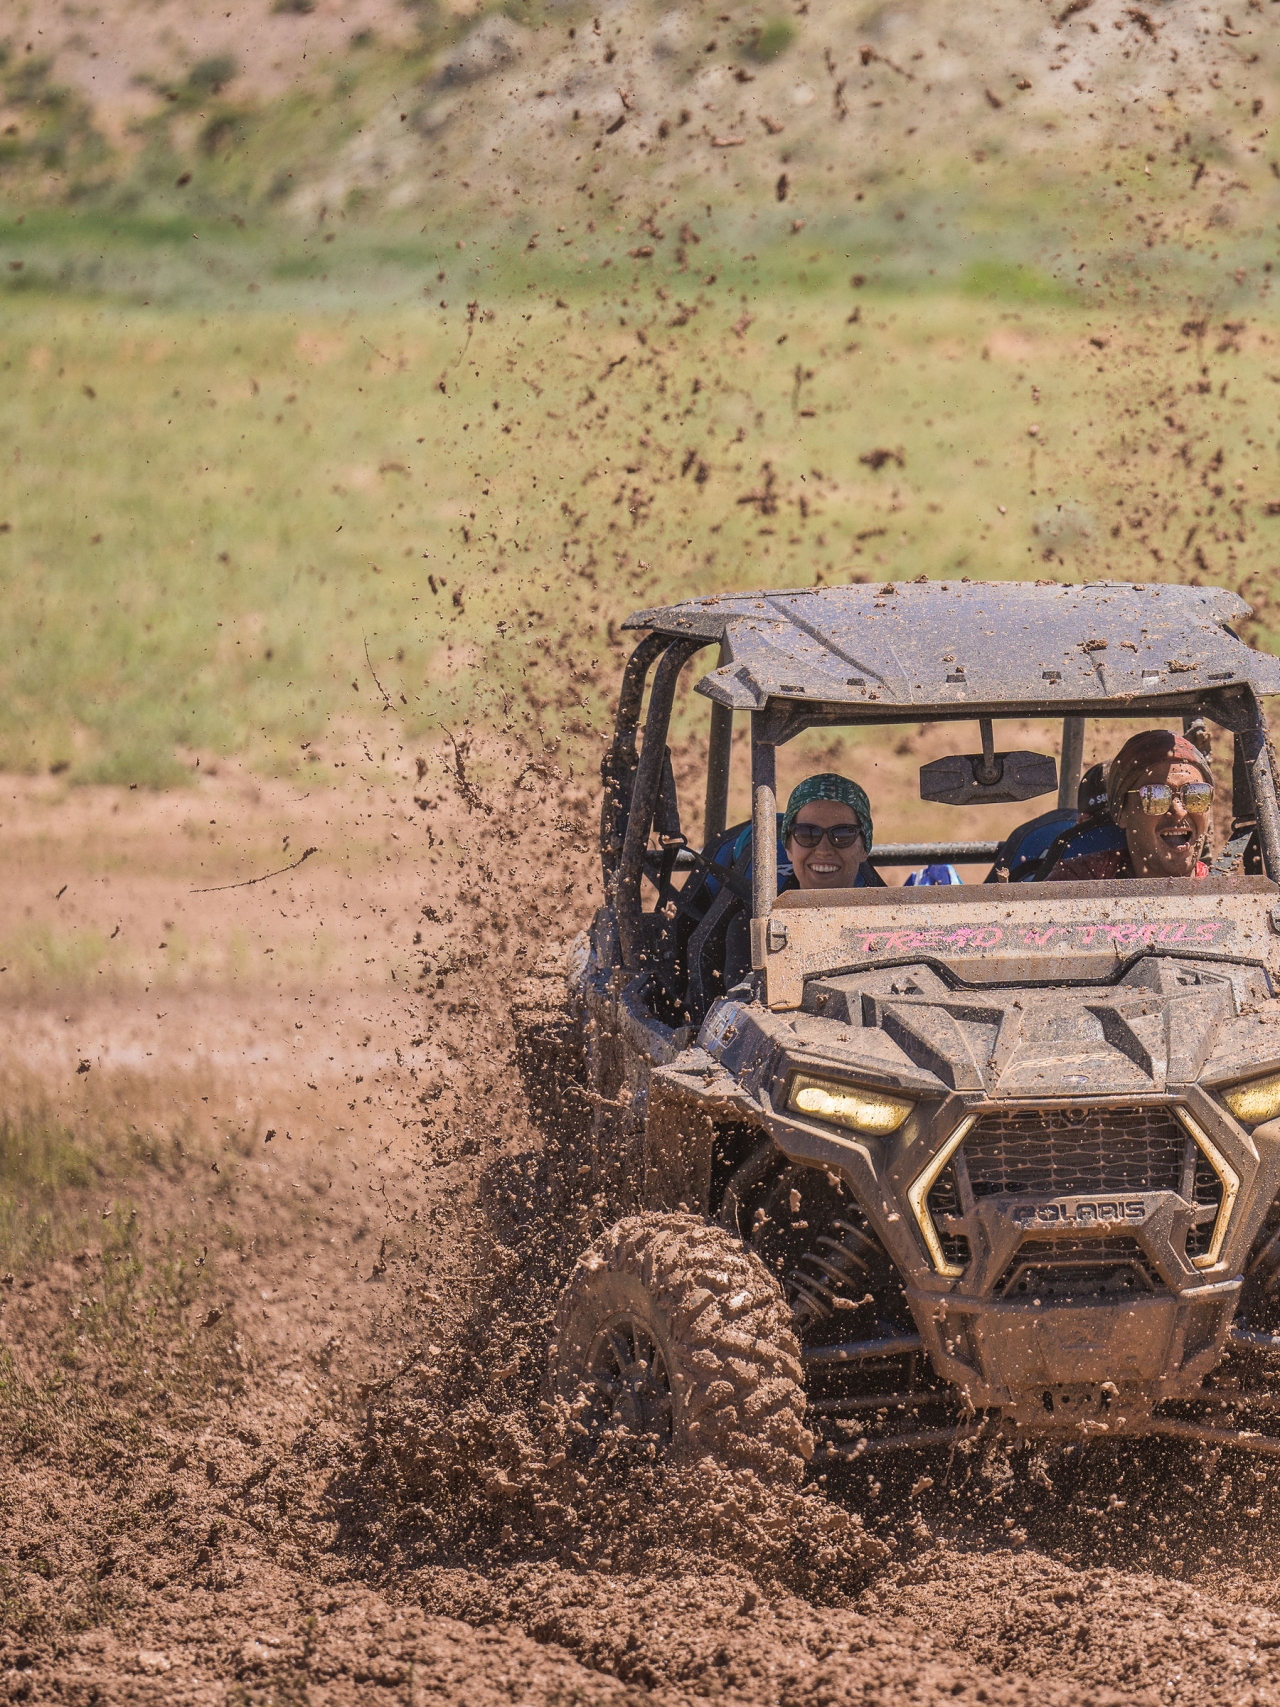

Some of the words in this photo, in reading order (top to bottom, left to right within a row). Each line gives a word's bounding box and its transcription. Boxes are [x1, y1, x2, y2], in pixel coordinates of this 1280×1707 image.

[855, 926, 1003, 952] TREAD
[1075, 922, 1223, 945] TRAILS
[1012, 1200, 1147, 1222] POLARIS
